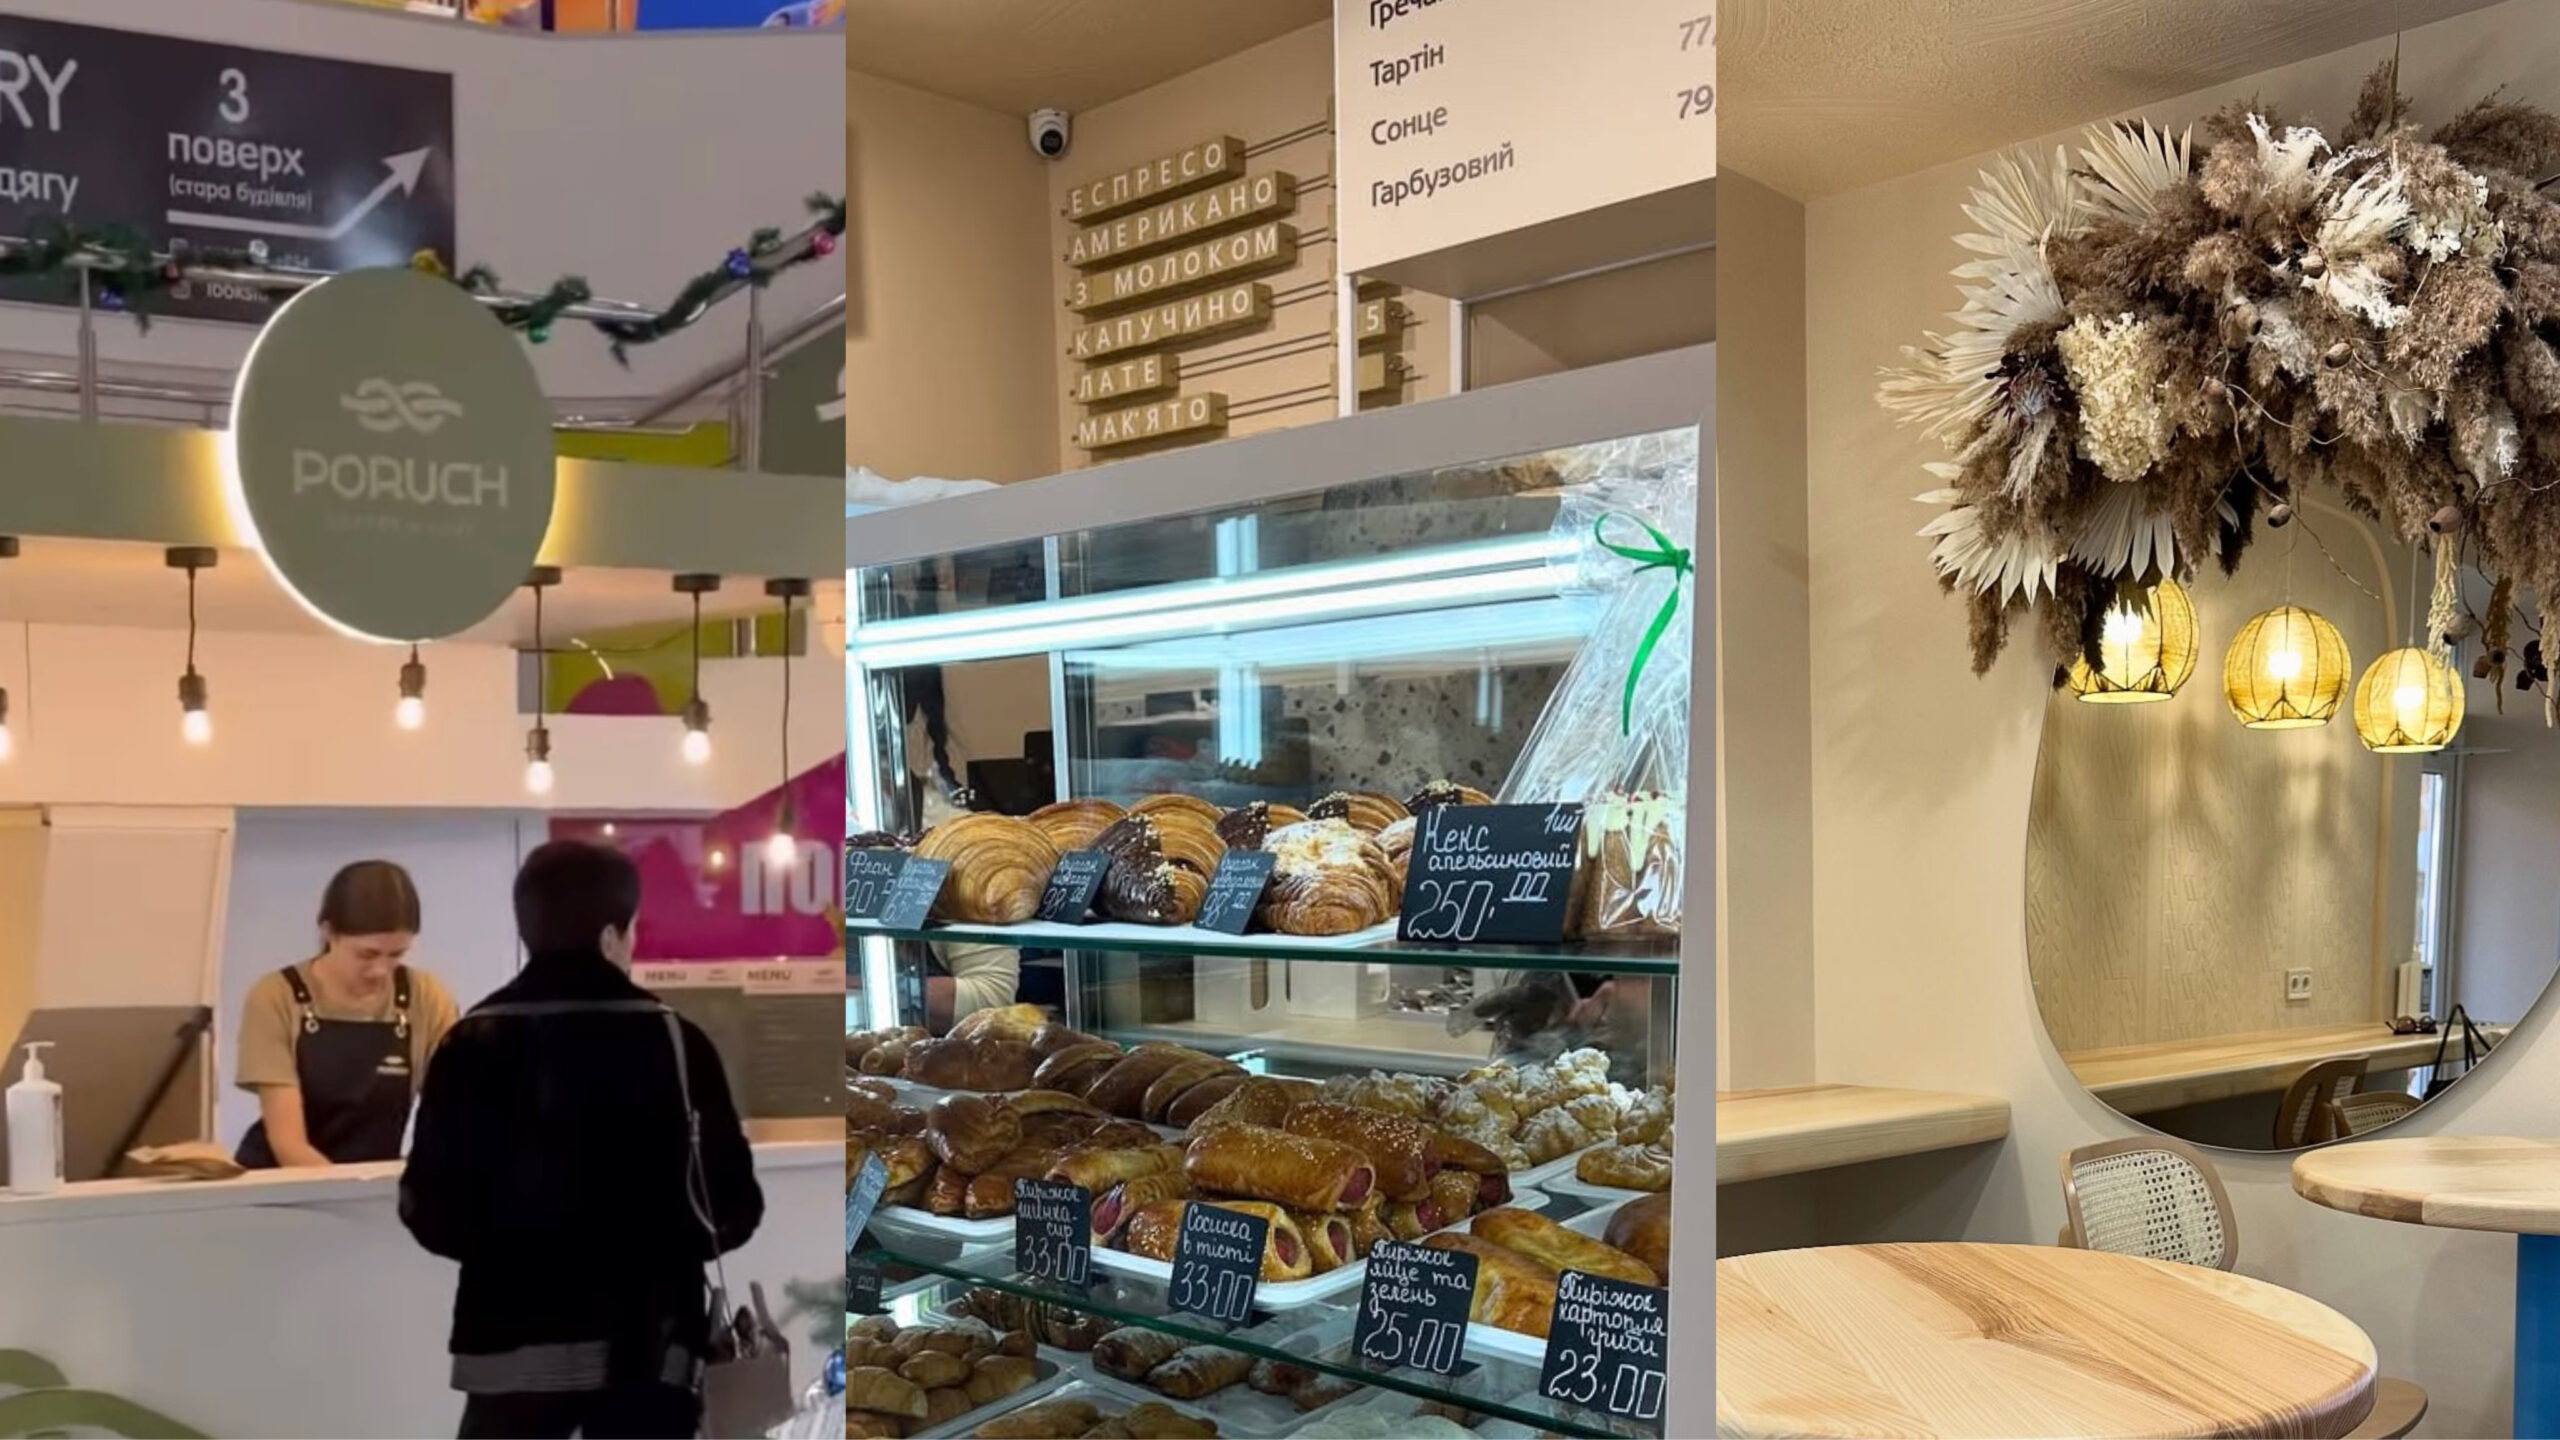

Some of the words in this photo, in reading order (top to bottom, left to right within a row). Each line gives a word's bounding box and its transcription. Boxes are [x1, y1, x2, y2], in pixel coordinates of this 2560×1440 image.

[1370, 44, 1444, 87] Тартін
[219, 68, 249, 123] 3
[1371, 105, 1448, 146] Сонце
[1677, 84, 1716, 120] 79
[167, 131, 305, 181] поверх
[1371, 142, 1514, 207] Гарбузовий
[169, 174, 231, 203] (стара
[236, 183, 312, 210] будівля)
[1071, 143, 1222, 214] ЕСПРЕСО
[1072, 178, 1273, 261] АМЕРИКАНО
[1115, 225, 1277, 296] МОЛОКОМ
[1076, 290, 1249, 356] КАПУЧИНО
[1366, 305, 1379, 331] 5
[1079, 361, 1157, 399] ЛАТЕ
[1079, 398, 1207, 445] МАК'ЯТО
[293, 450, 508, 509] PORUCH
[1422, 804, 1490, 853] Кекс
[741, 840, 846, 916] ПО
[1429, 844, 1572, 872] апельсиновий
[747, 969, 793, 982] MENU
[1187, 1203, 1253, 1241] Сосиска
[1197, 1238, 1255, 1263] тісті
[1371, 1240, 1454, 1267] Пиріжок
[1370, 1260, 1420, 1286] яйце
[1432, 1272, 1471, 1290] та
[1559, 1272, 1657, 1312] Пиріжок
[1369, 1282, 1436, 1318] зелень
[1559, 1302, 1667, 1337] картопля
[1587, 1328, 1659, 1362] гриби
